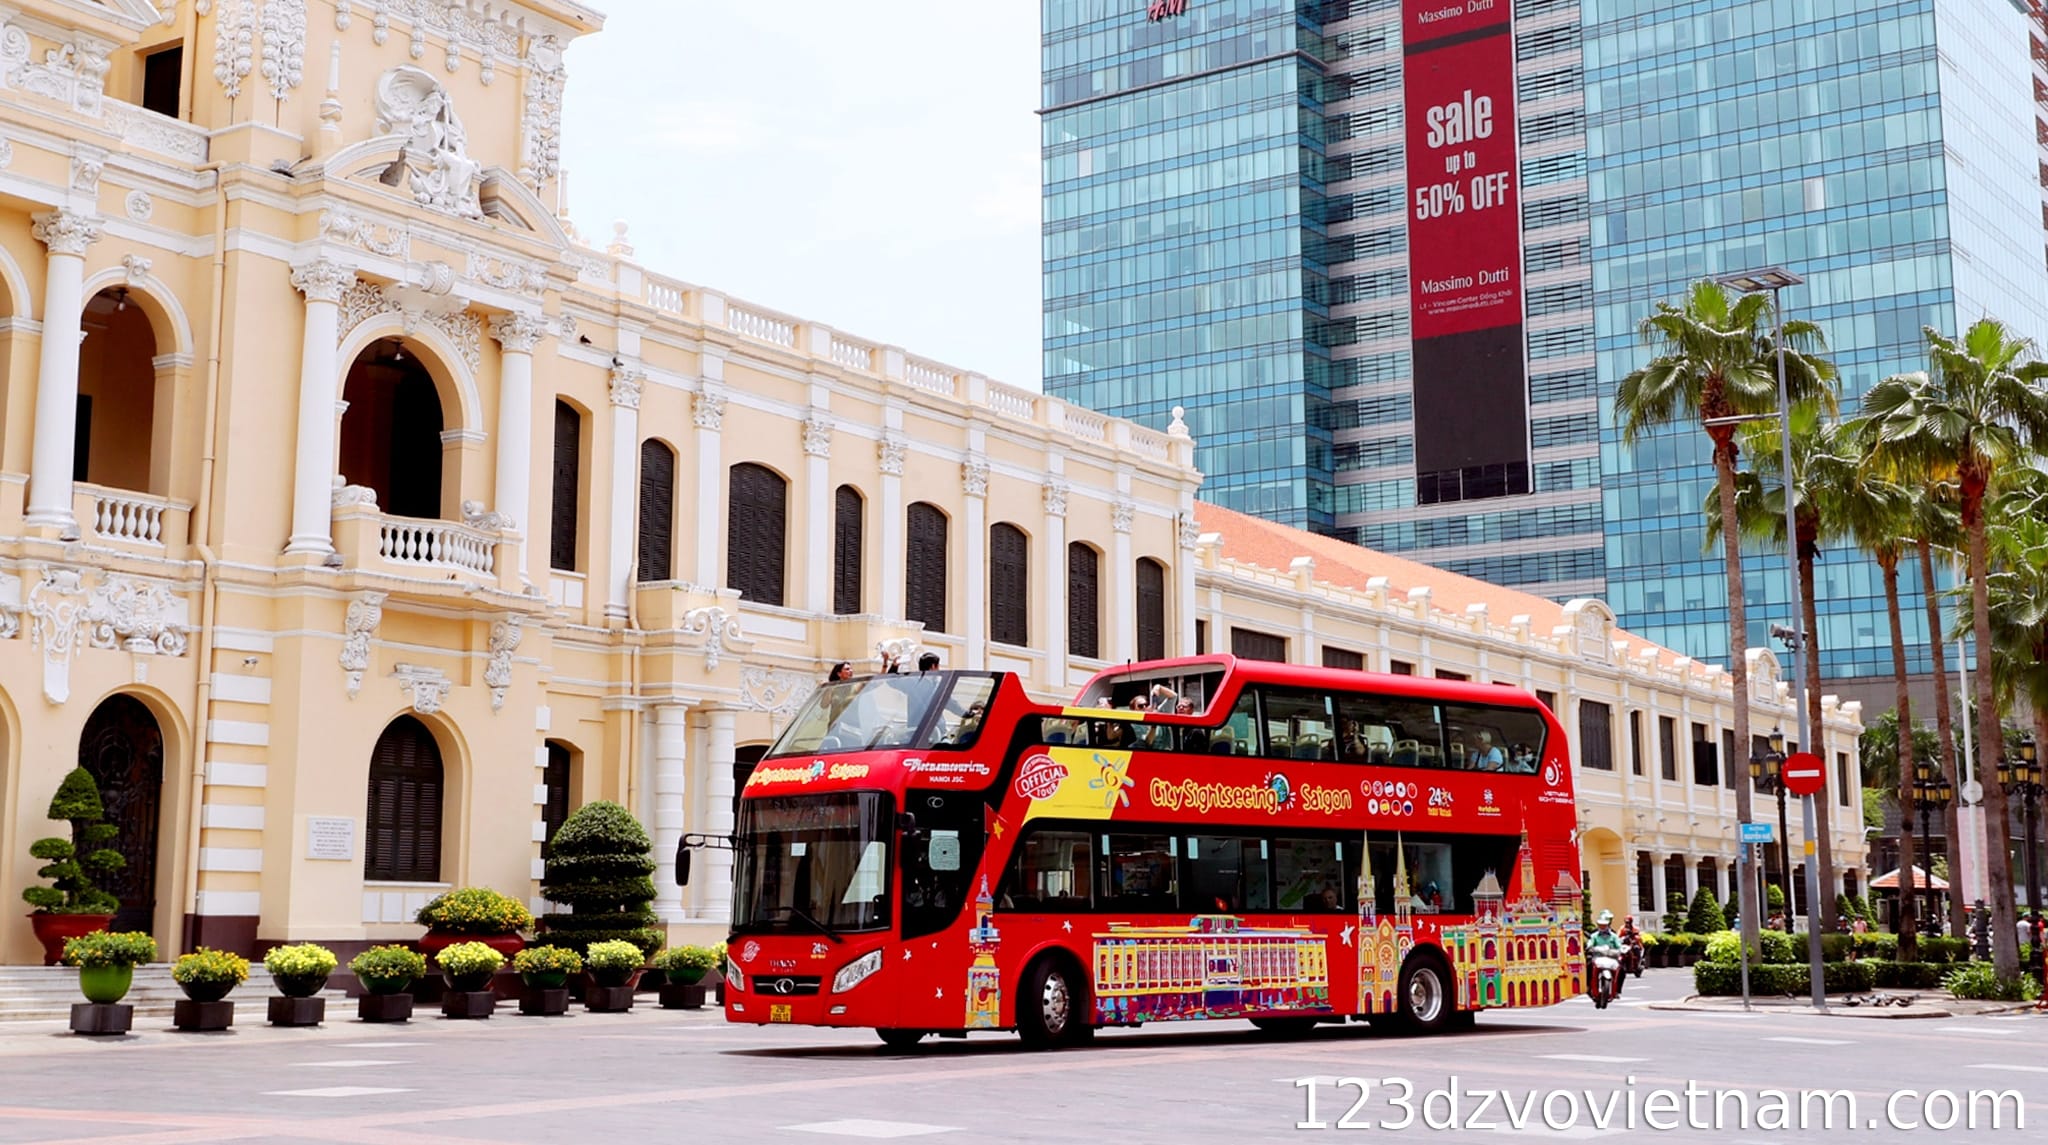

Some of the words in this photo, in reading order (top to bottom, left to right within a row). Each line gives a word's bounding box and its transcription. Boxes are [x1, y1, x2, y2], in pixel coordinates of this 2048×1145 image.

[1418, 6, 1463, 24] Massimo
[1467, 0, 1494, 13] Dutti
[1426, 89, 1493, 148] sale
[1445, 154, 1460, 175] up
[1463, 150, 1476, 169] to
[1416, 180, 1465, 220] 50%
[1471, 171, 1509, 210] OFF
[1421, 275, 1473, 294] Massimo
[1478, 266, 1509, 286] Dutti
[1021, 766, 1067, 792] OFFICIAL
[1300, 783, 1352, 815] Saigon
